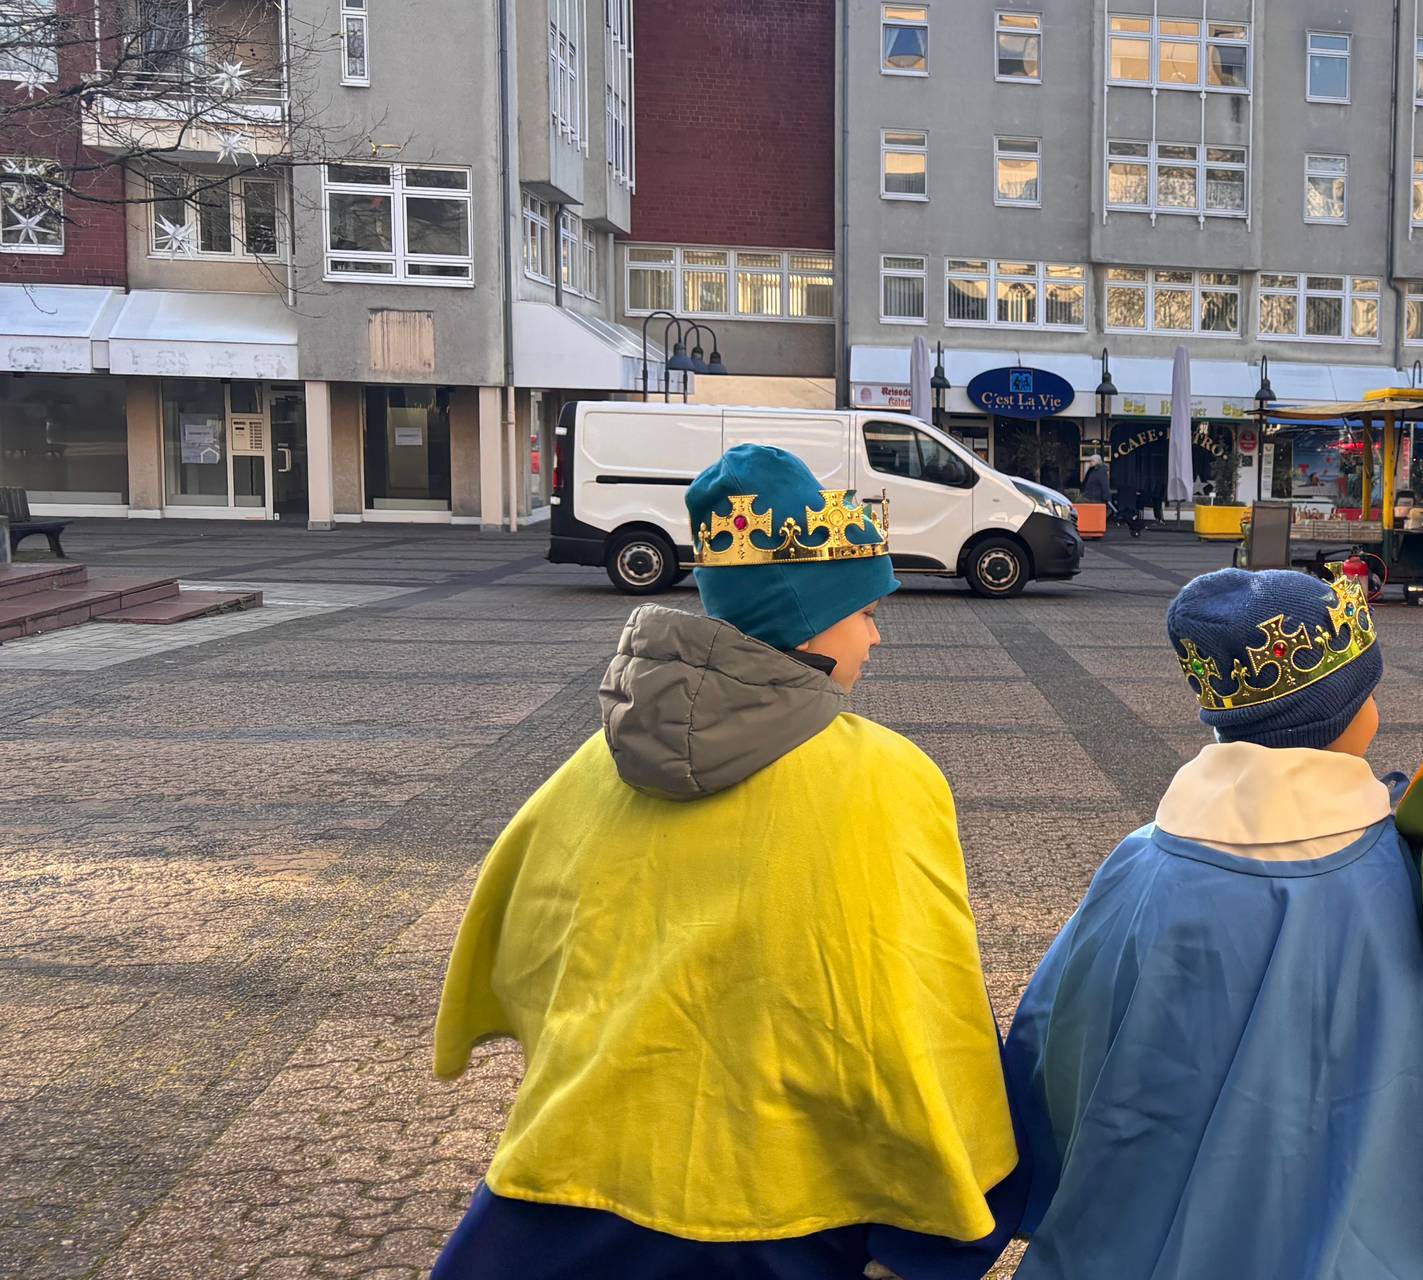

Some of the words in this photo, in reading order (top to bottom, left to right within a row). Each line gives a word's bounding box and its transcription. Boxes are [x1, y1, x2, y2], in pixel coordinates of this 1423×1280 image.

[881, 386, 912, 397] Reissdo
[1017, 393, 1036, 406] La
[1038, 393, 1063, 408] Vie
